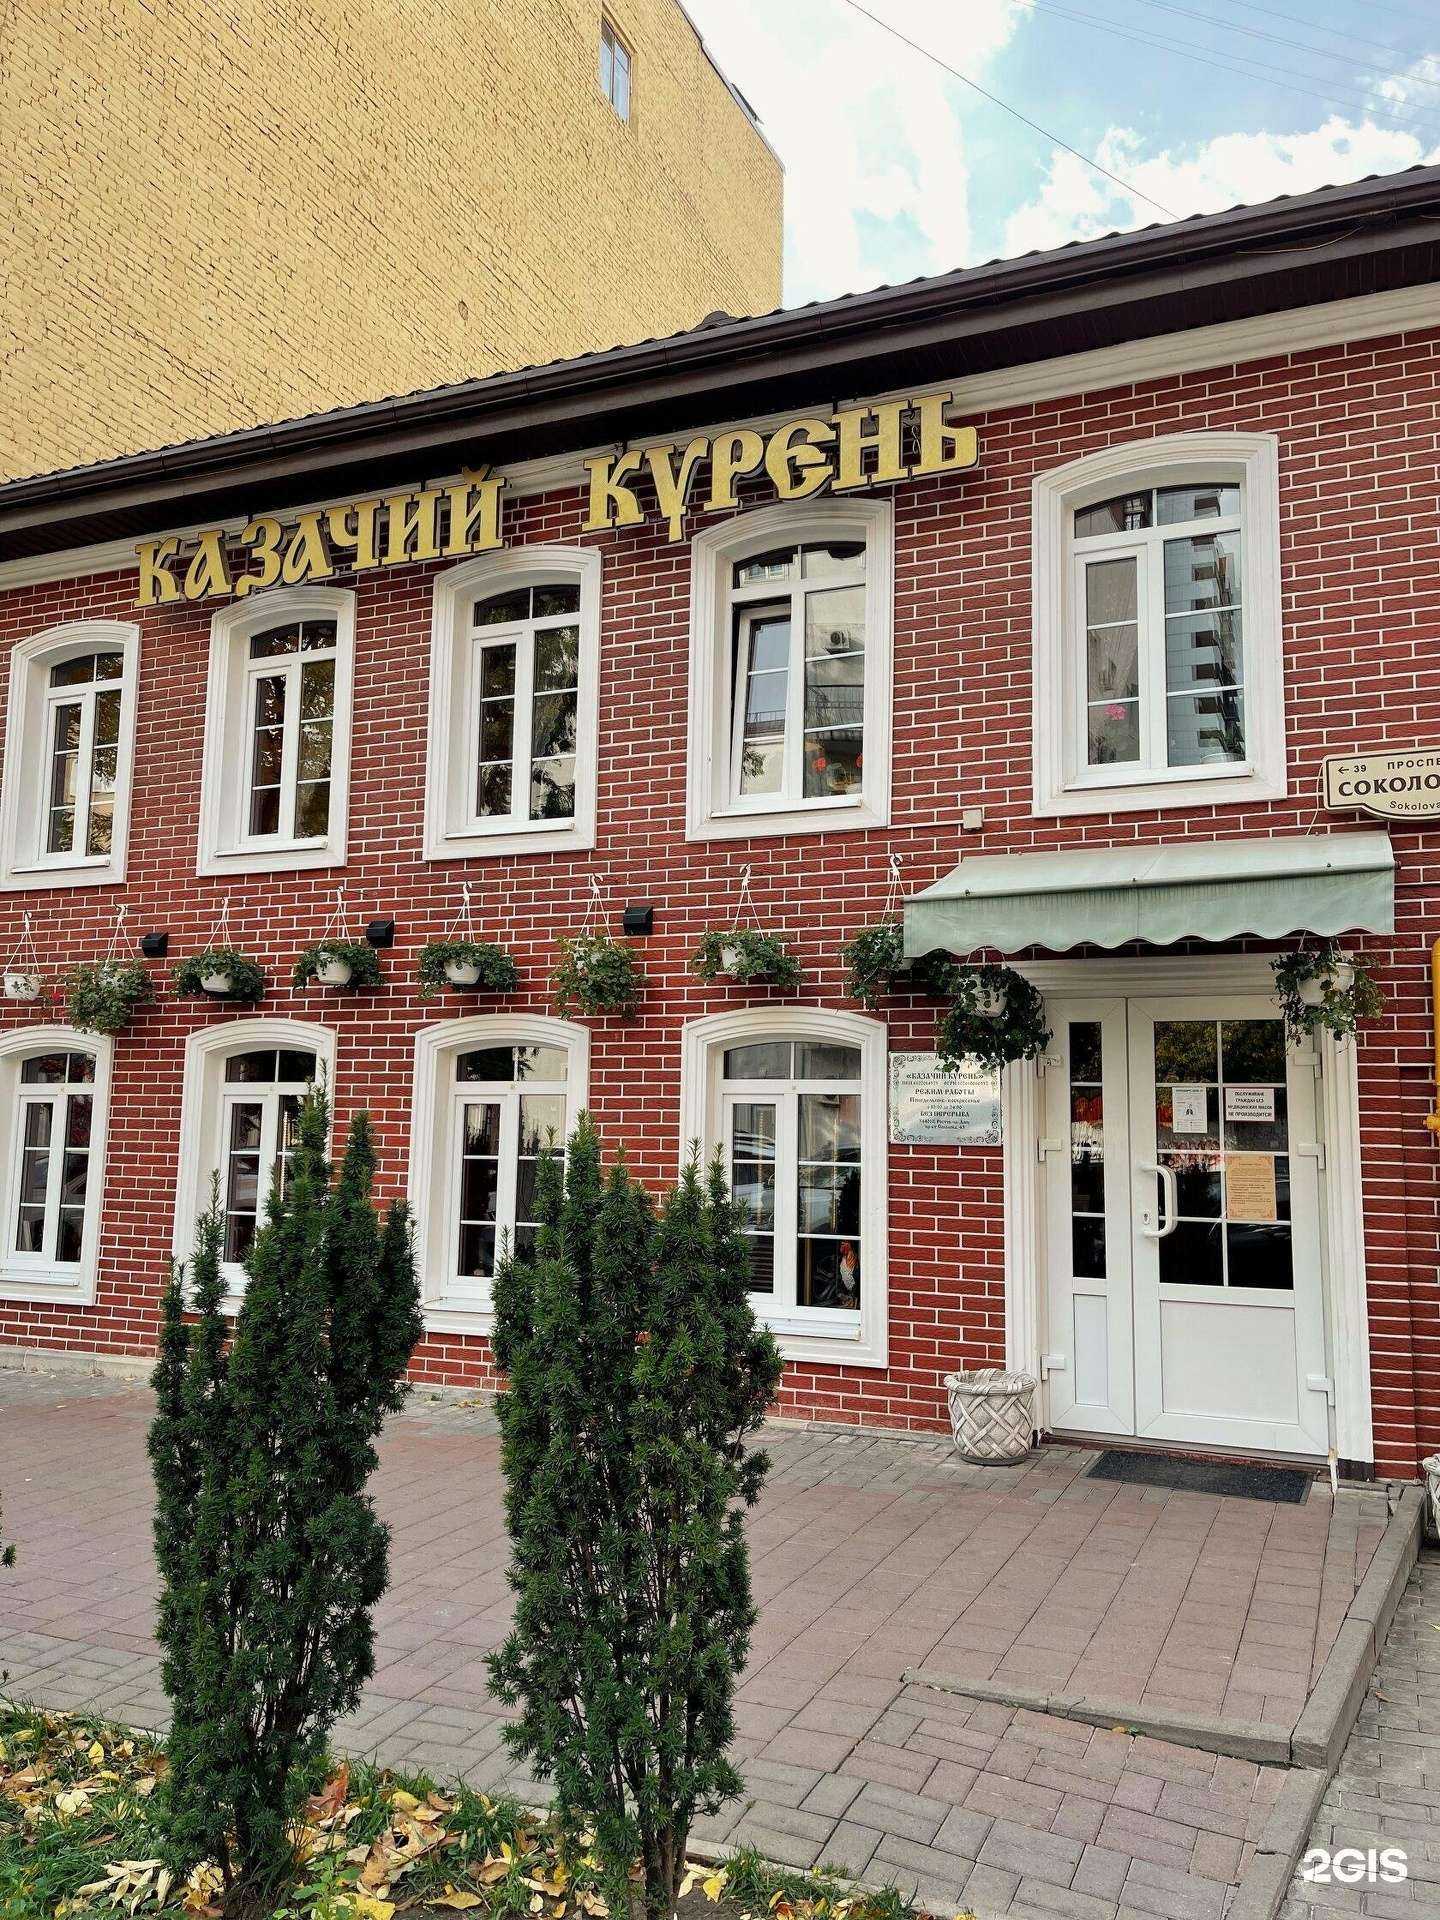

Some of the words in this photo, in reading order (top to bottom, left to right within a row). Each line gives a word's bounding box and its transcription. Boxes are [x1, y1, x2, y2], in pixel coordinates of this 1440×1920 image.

[134, 464, 505, 608] КАЗАЧИЙ
[1353, 764, 1367, 773] 39
[1338, 773, 1440, 797] СОКОЛО
